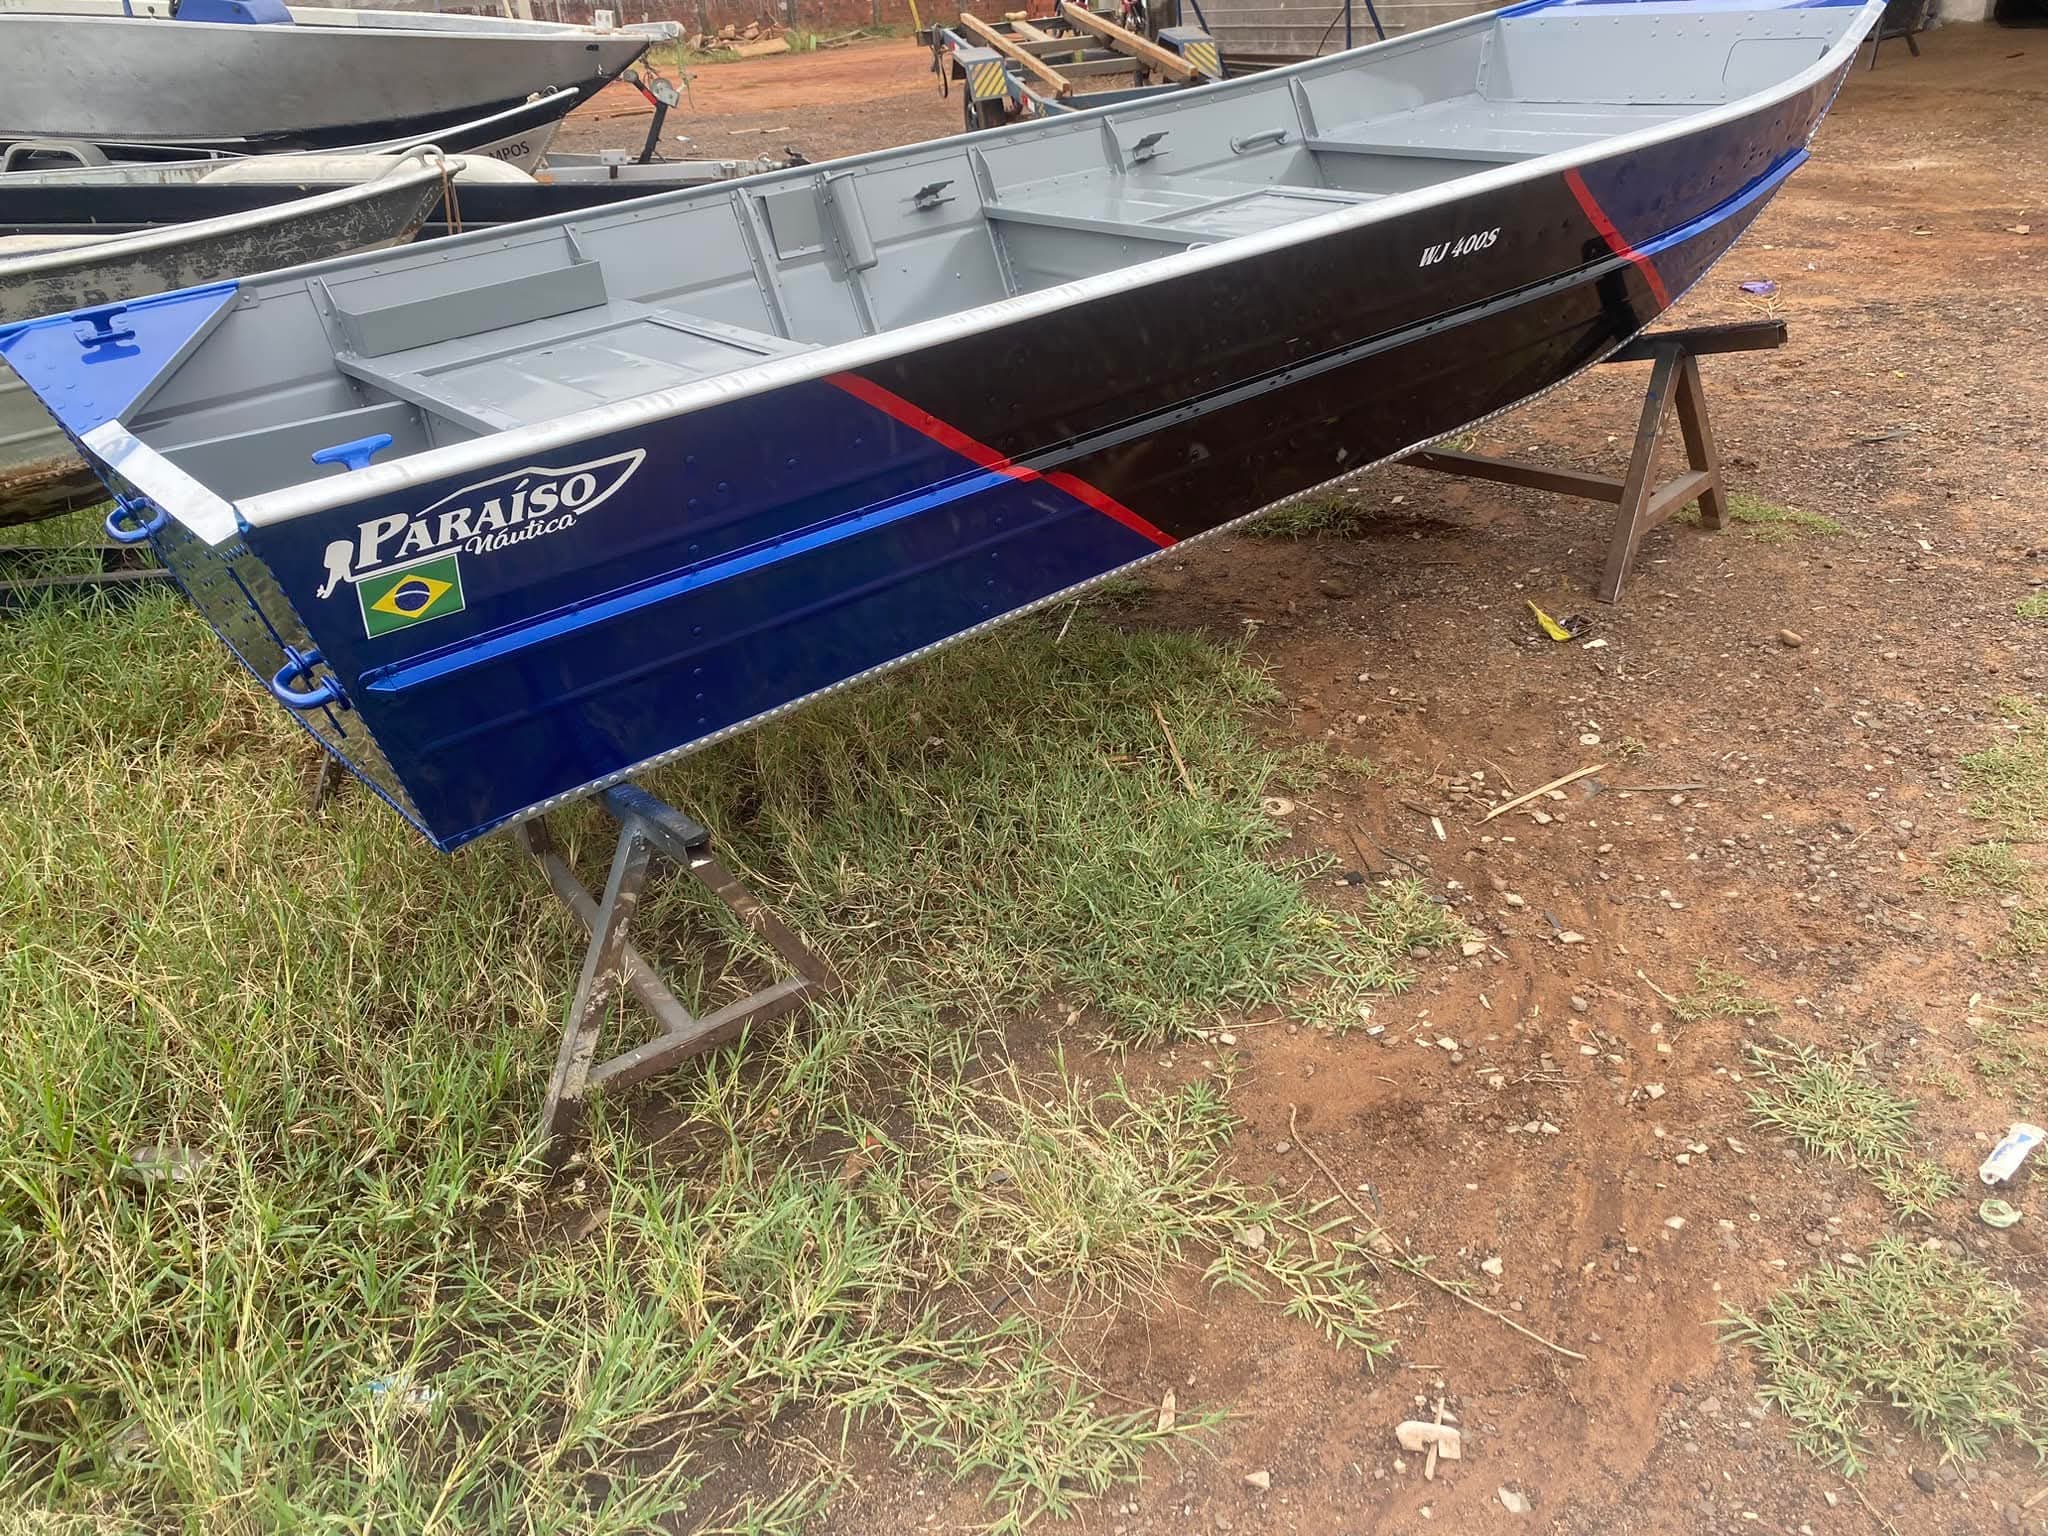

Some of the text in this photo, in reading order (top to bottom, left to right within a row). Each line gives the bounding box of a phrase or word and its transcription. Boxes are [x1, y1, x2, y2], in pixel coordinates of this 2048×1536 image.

[1419, 227, 1501, 268] WJ 400S
[354, 473, 597, 570] PARAÍSO
[465, 514, 577, 555] Náutica
